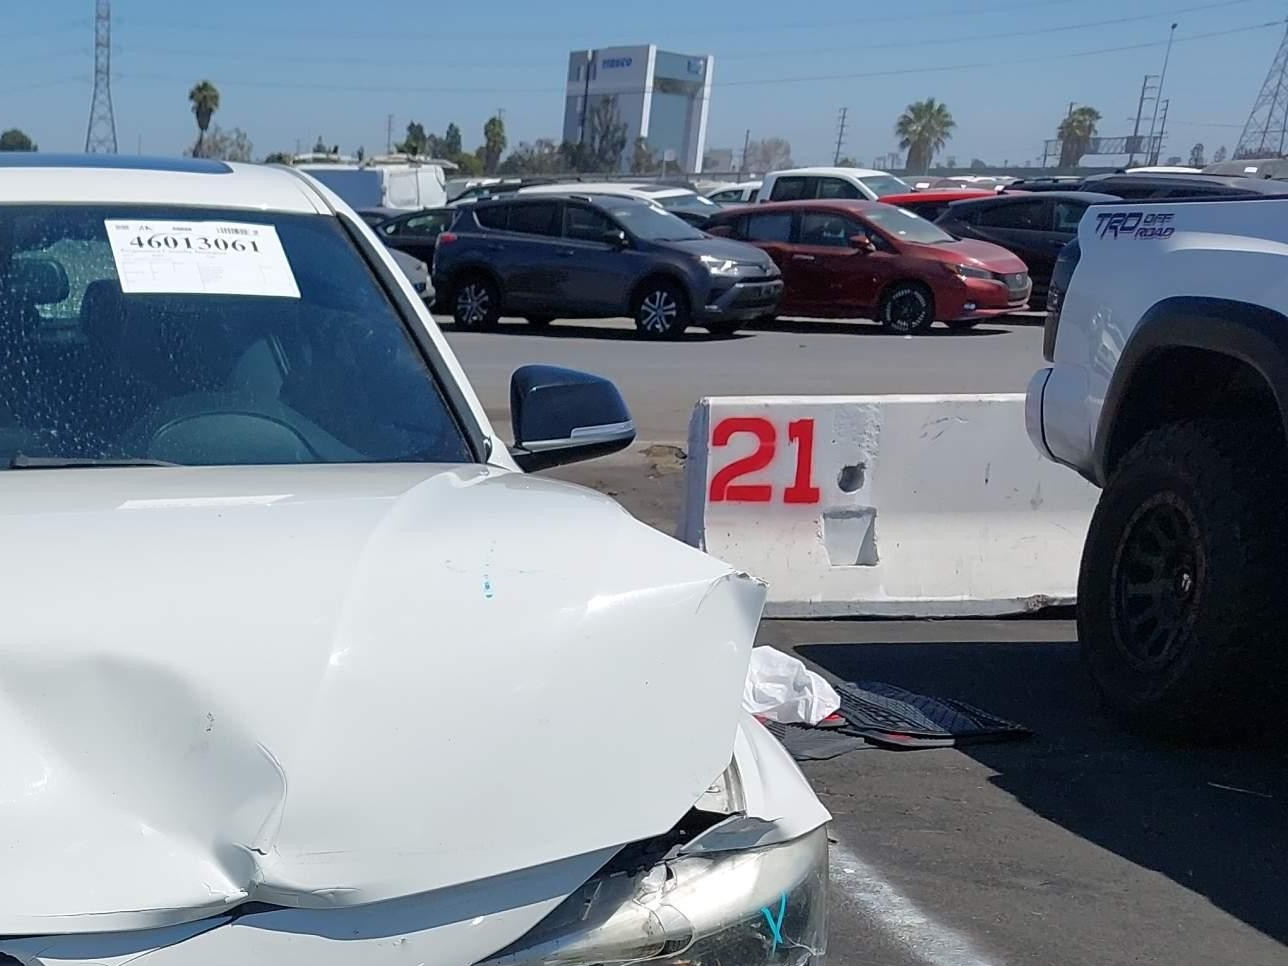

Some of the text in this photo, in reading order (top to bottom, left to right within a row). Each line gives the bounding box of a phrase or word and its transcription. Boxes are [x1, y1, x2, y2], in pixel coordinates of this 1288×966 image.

[1095, 212, 1176, 240] TRD OFF
[1135, 227, 1175, 239] ROAD
[129, 232, 263, 253] 46013061
[710, 416, 820, 504] 21
